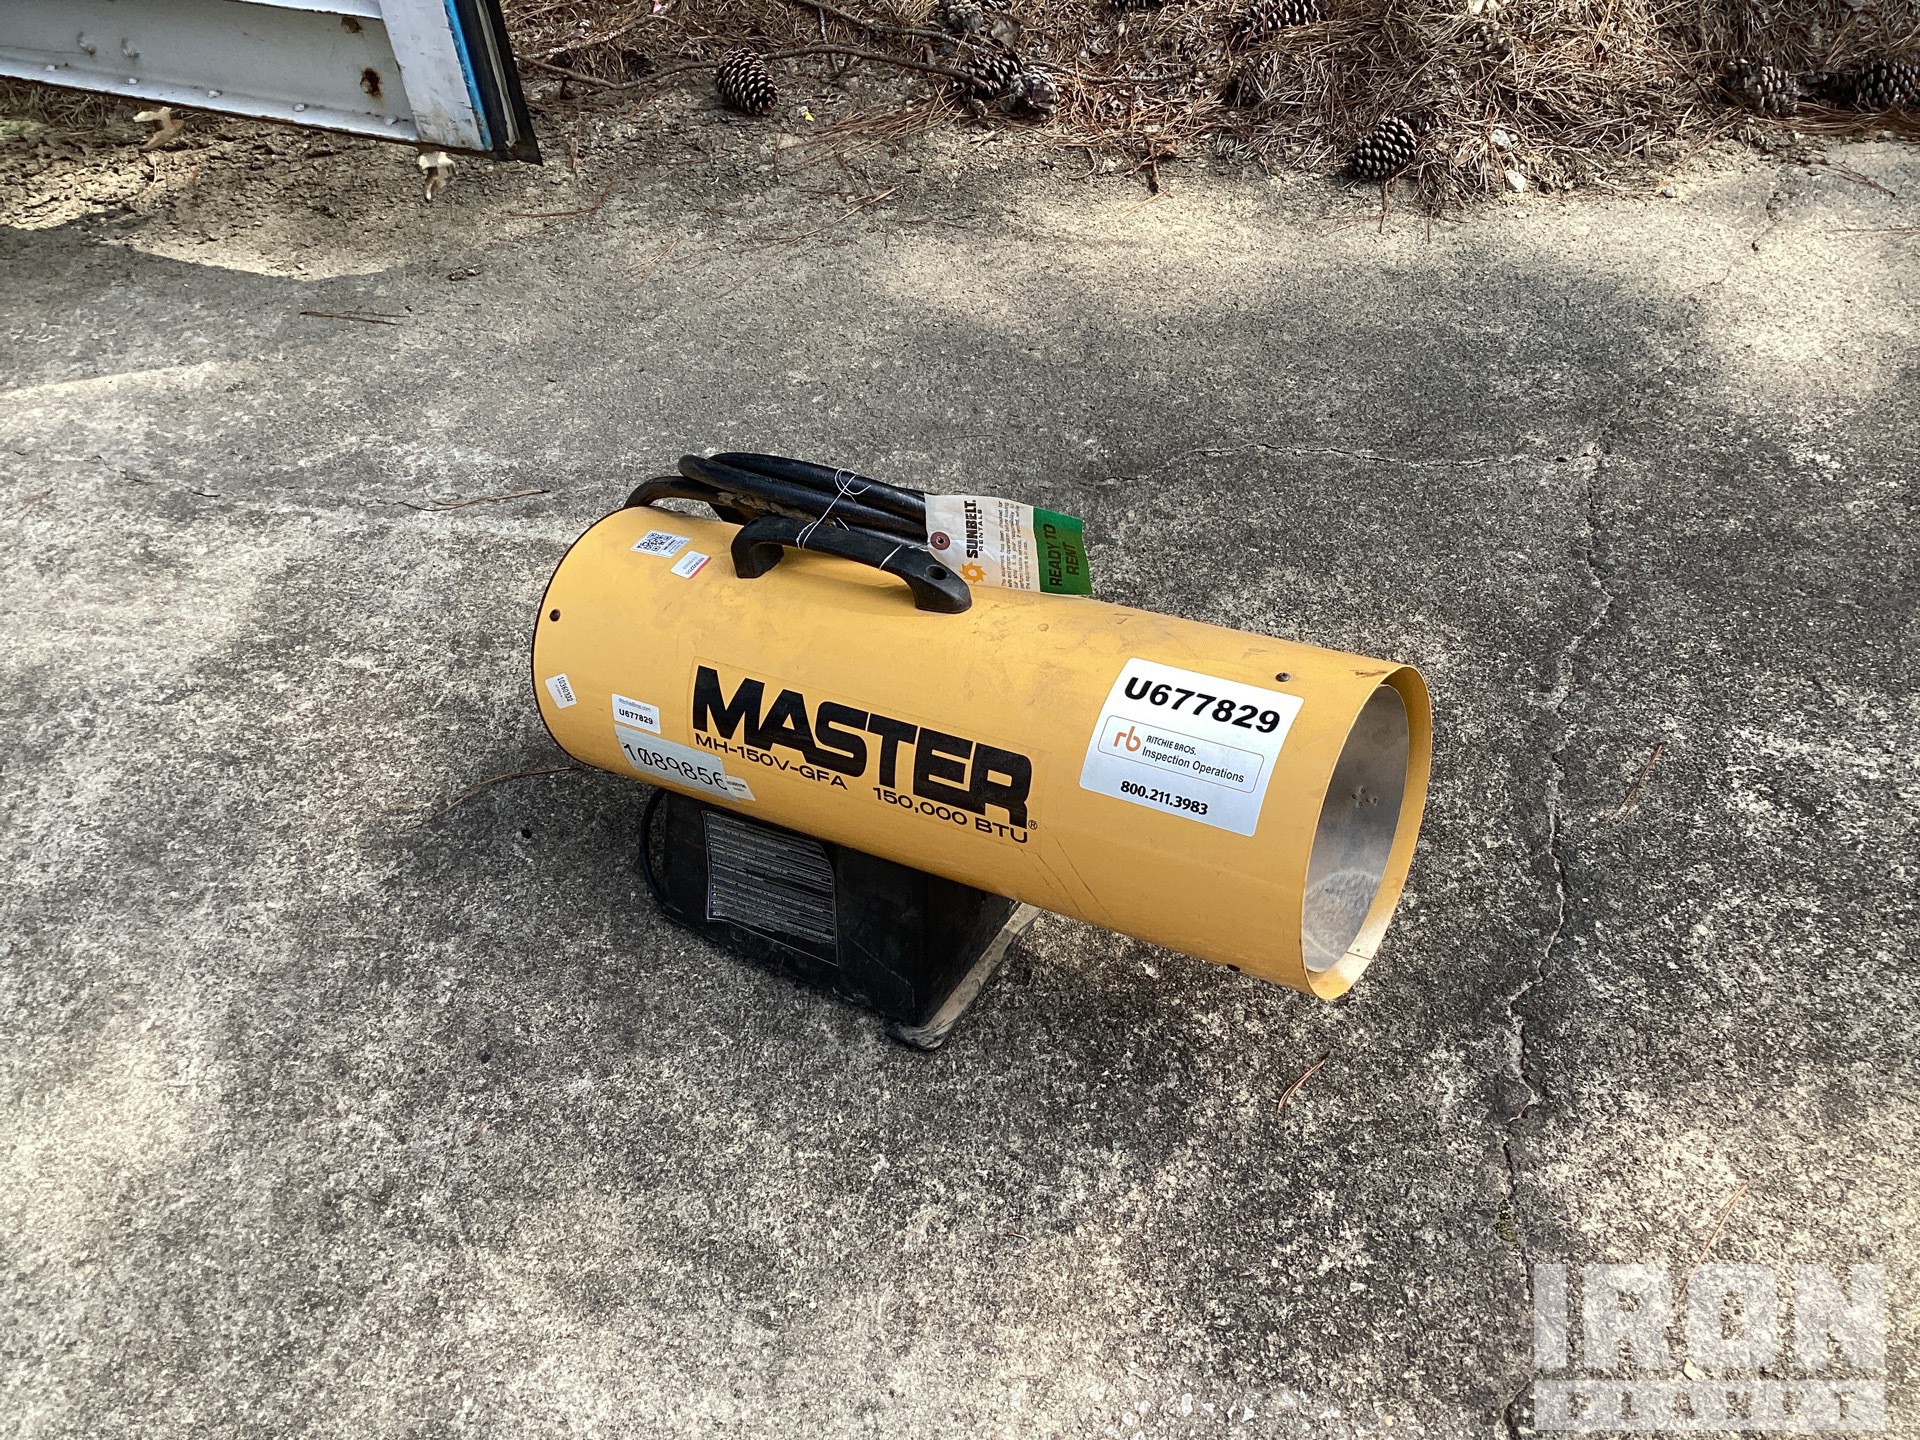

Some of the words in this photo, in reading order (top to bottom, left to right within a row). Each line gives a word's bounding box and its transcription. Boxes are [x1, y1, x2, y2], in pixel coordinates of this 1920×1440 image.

[964, 501, 979, 558] SUNBELT
[1043, 523, 1056, 541] TO
[1046, 543, 1063, 587] READY
[1064, 543, 1080, 576] RENT
[618, 708, 654, 725] U677829
[1124, 676, 1281, 733] U677829
[692, 665, 1032, 830] MASTER
[1113, 725, 1141, 752] rb
[1146, 735, 1174, 749] RITCHIE
[1174, 742, 1197, 755] BROS.
[694, 732, 849, 790] MH-150V-GFA
[1142, 746, 1190, 769] Inspection
[1192, 760, 1245, 783] Operations
[872, 787, 968, 826] 150,000
[974, 817, 1028, 844] BTU
[1120, 781, 1209, 816] 800.211.3983
